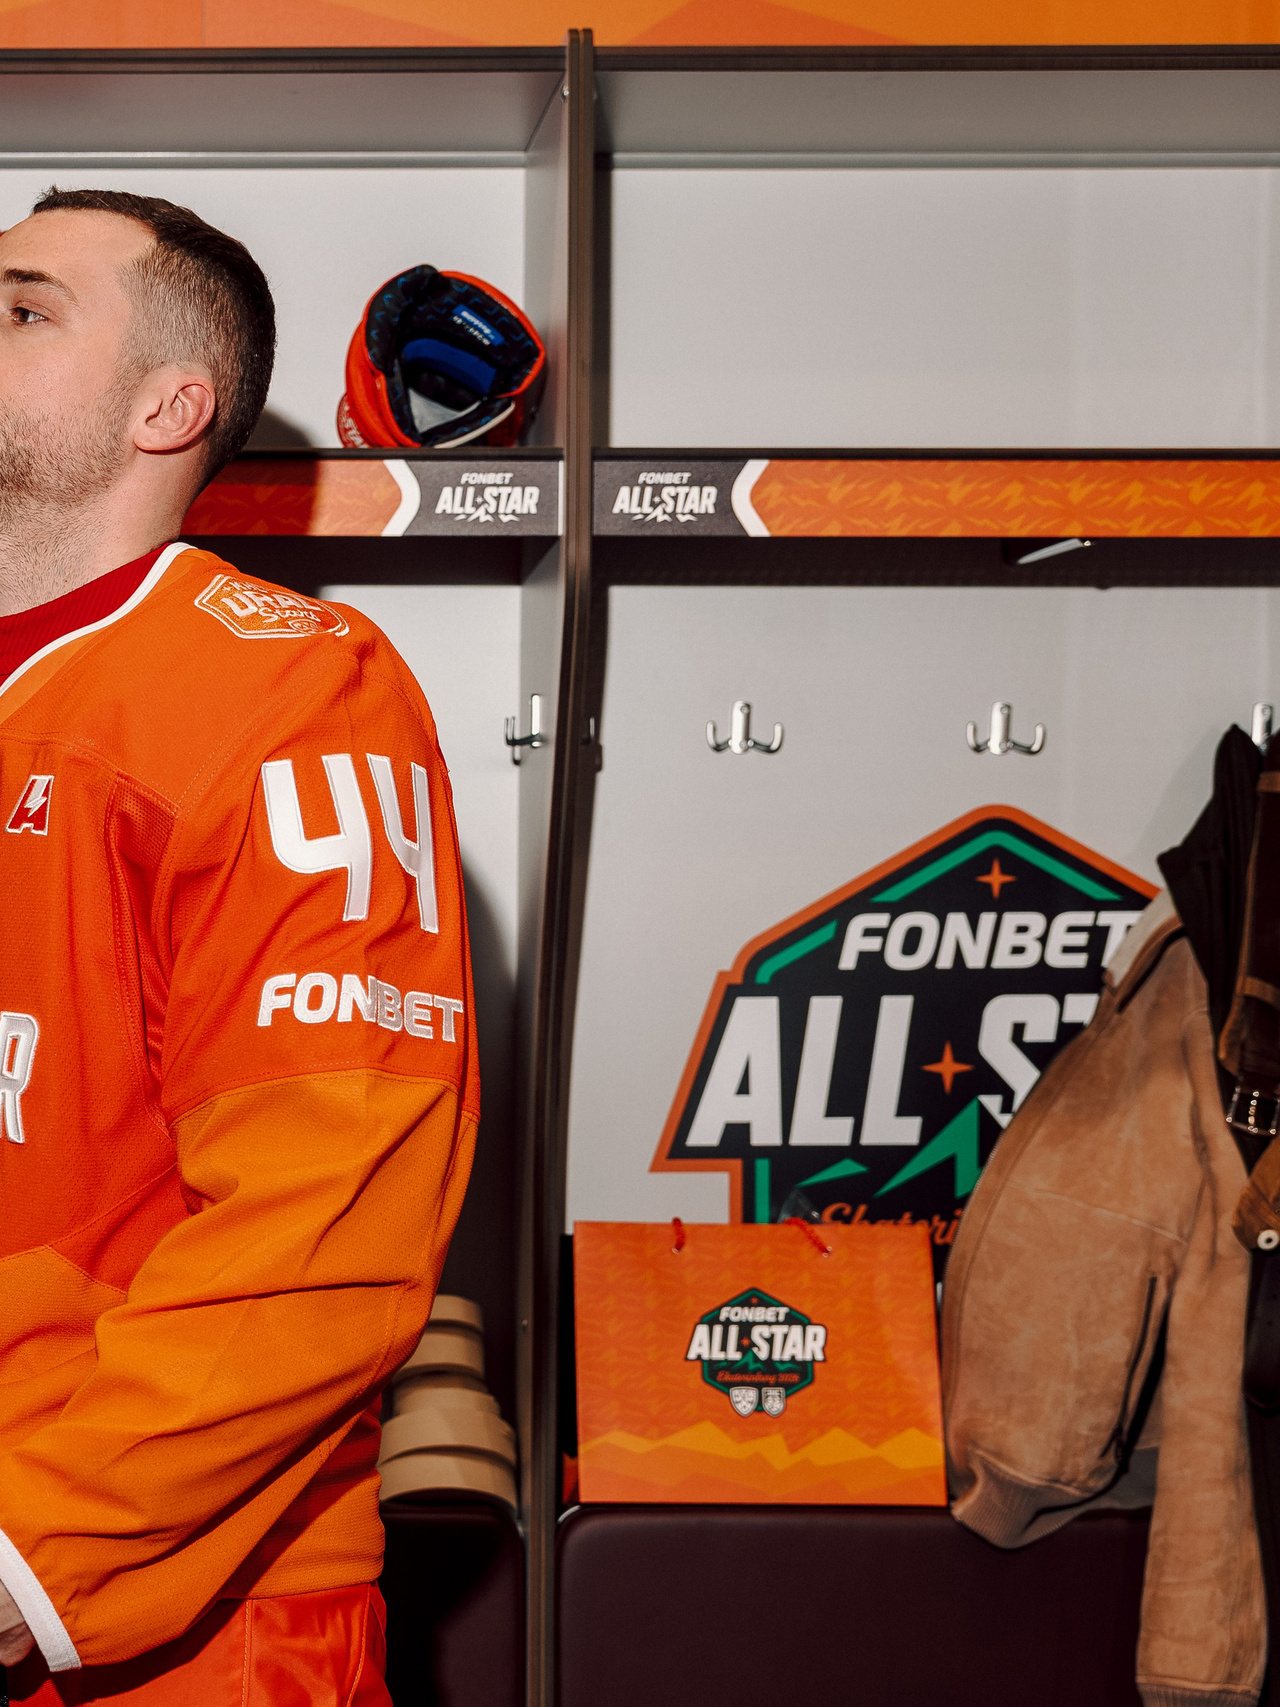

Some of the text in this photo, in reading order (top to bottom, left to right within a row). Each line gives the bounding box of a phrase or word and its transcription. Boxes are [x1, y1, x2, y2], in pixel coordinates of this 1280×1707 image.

[460, 472, 514, 485] FONBET
[638, 472, 692, 485] FONBET
[435, 486, 540, 515] ALL STAR
[612, 486, 718, 515] ALL STAR
[220, 590, 323, 617] URAL
[261, 753, 439, 933] 44
[257, 972, 464, 1043] FONBET
[684, 994, 923, 1147] ALL
[719, 1306, 790, 1322] FONBET
[686, 1324, 826, 1361] ALL STAR
